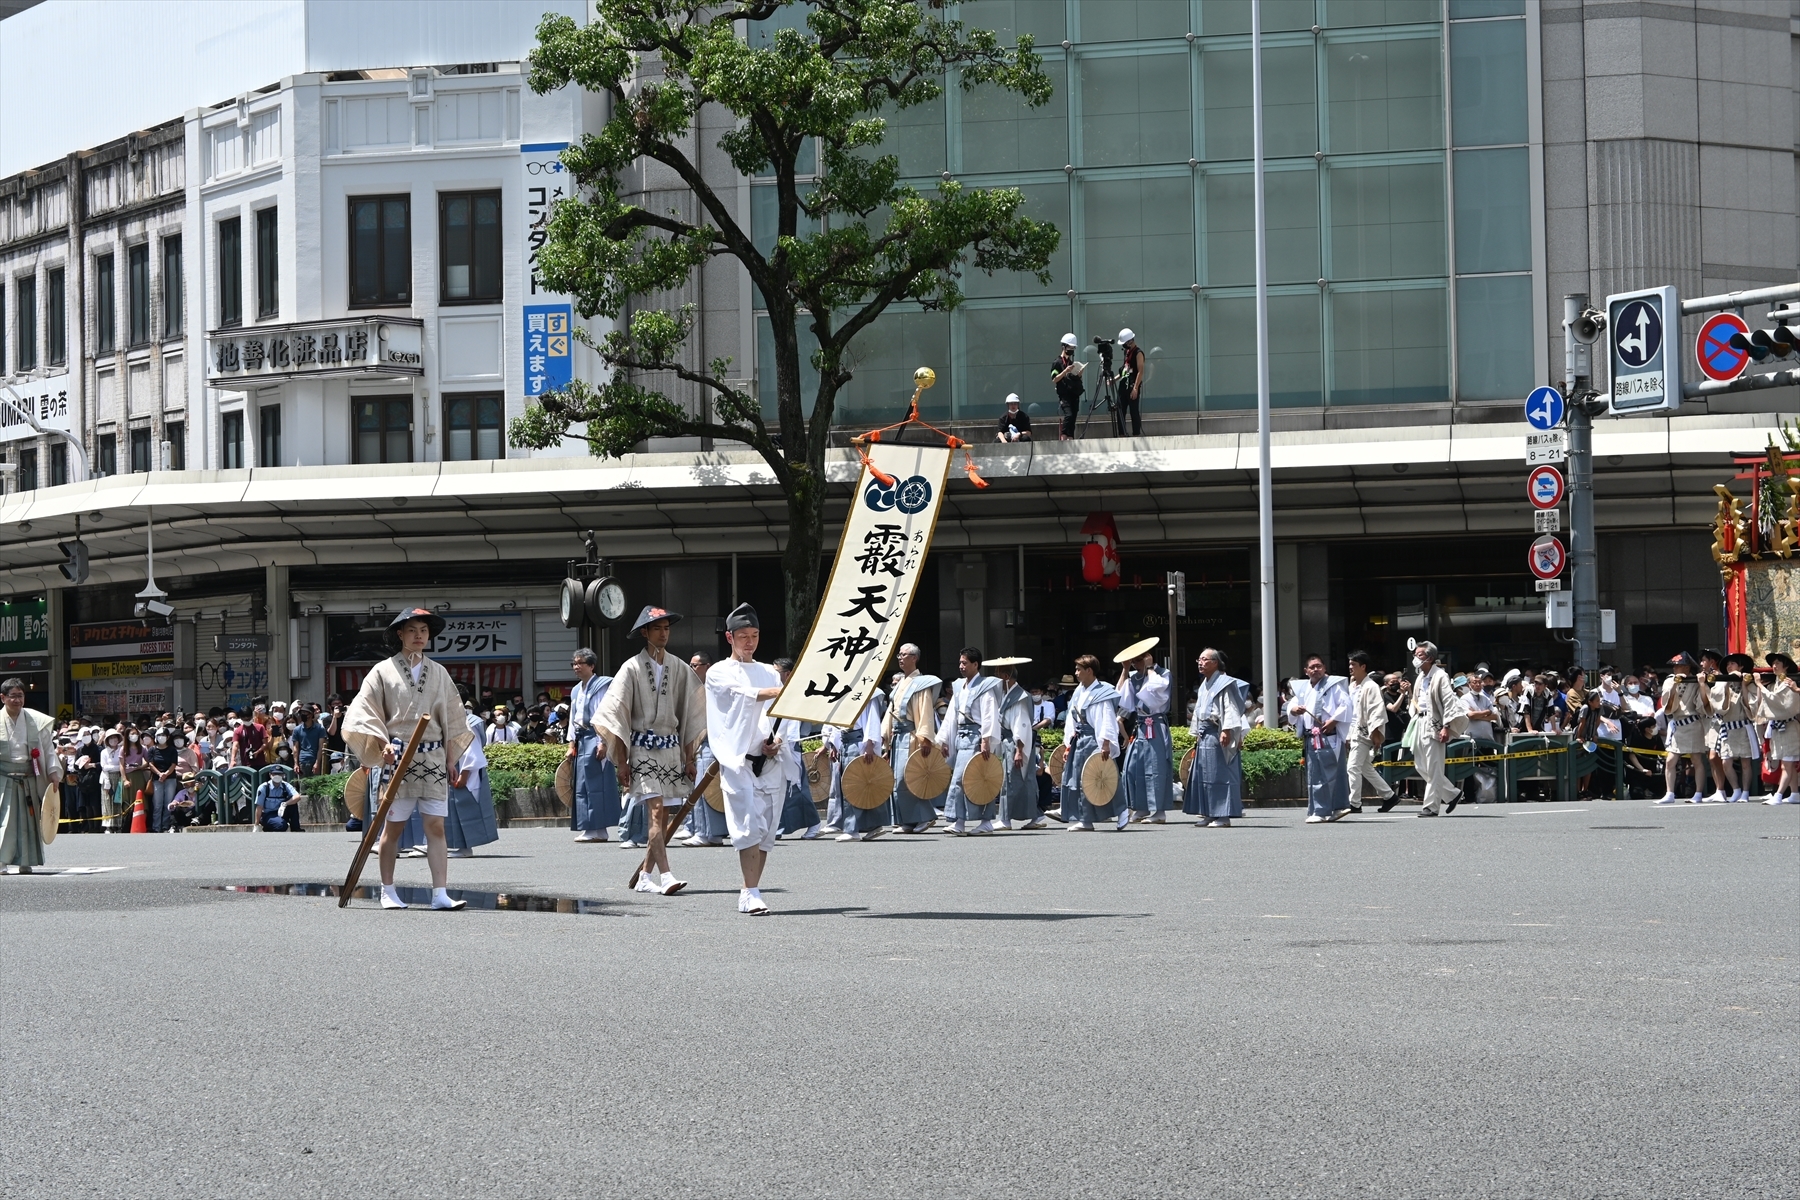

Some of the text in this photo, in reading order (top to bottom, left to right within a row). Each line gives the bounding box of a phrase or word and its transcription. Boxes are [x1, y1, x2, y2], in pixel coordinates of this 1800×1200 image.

[549, 314, 566, 355] すぐ
[216, 331, 368, 372] 池善化粧品店
[528, 314, 546, 393] 買えます
[1616, 377, 1663, 396] 路線バスを除く
[40, 390, 67, 420] 雲の茶
[448, 621, 507, 631] メガネスーパー
[1158, 616, 1223, 627] Taashimaya
[140, 641, 174, 653] ACCESS TICKET
[92, 663, 140, 677] Money EXchange
